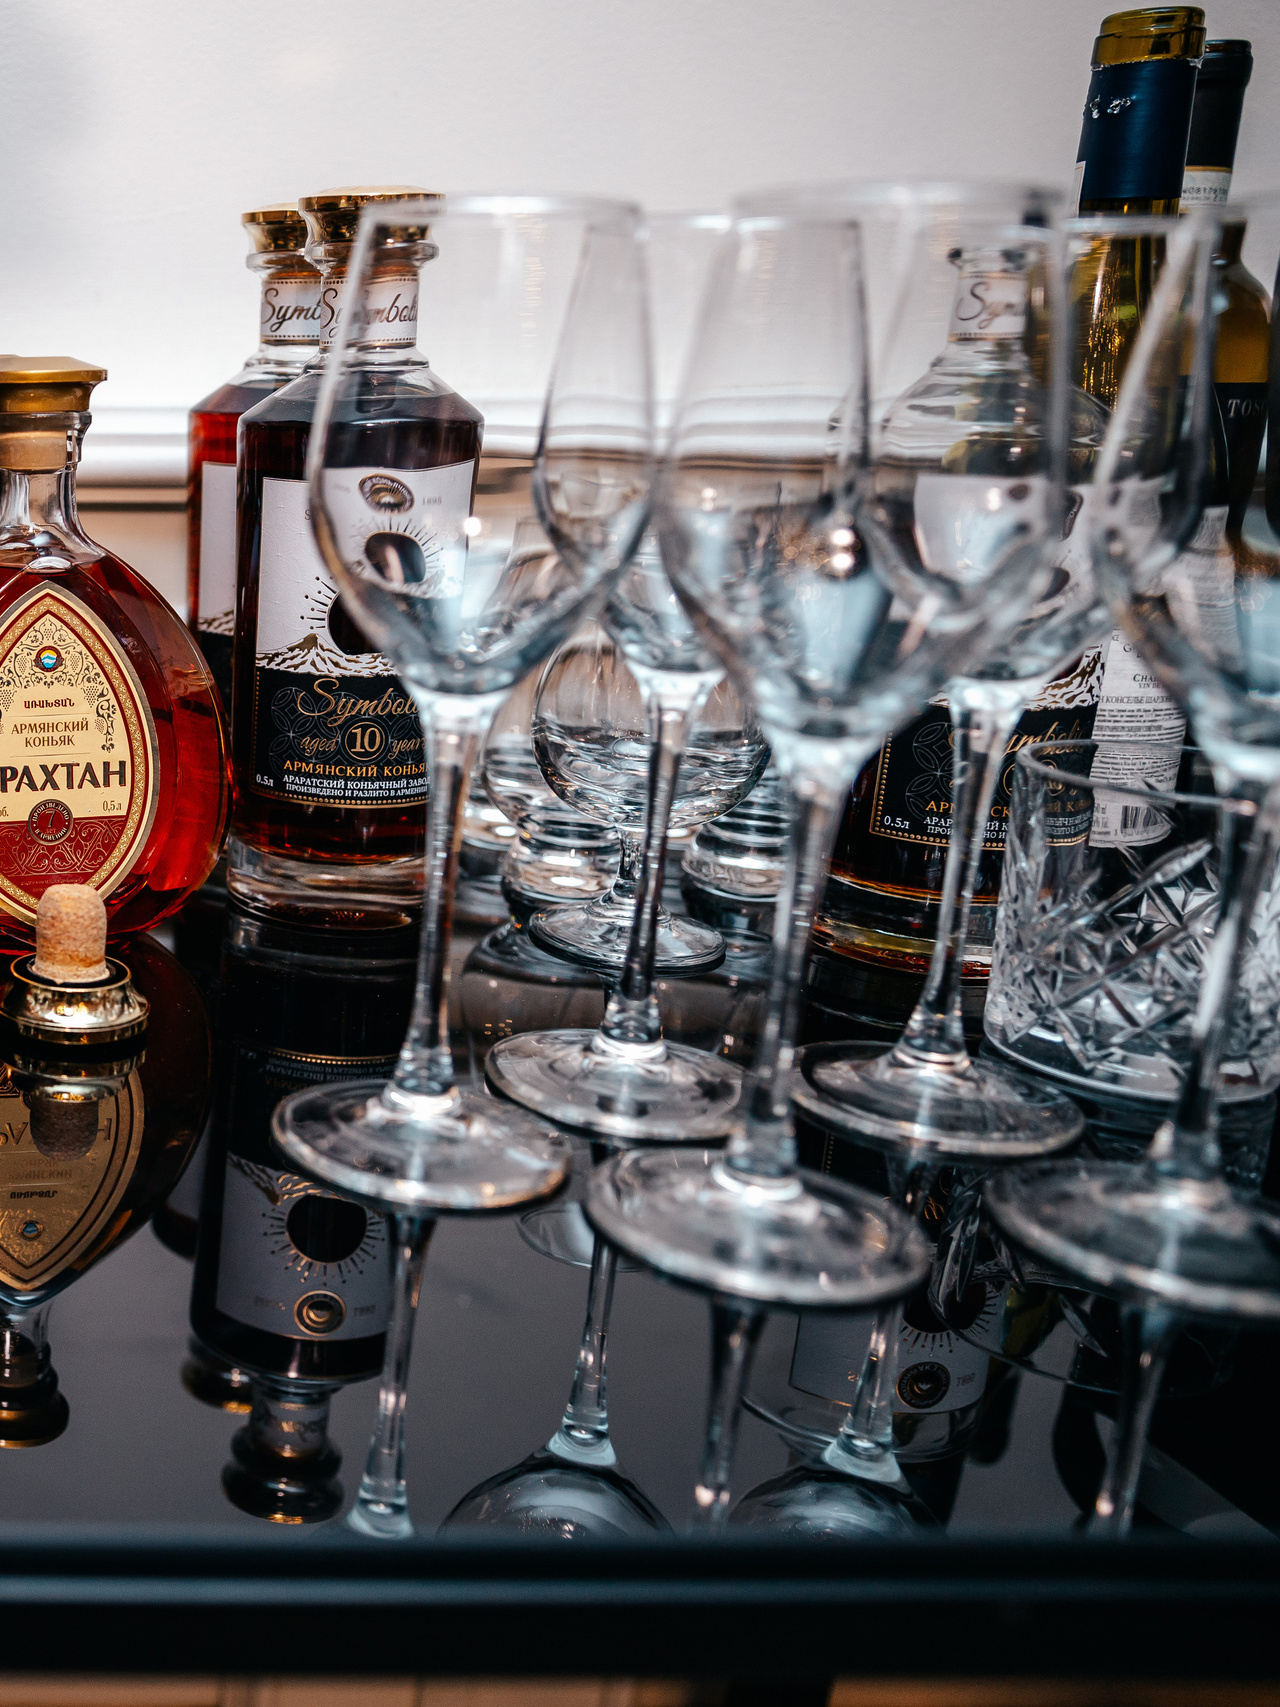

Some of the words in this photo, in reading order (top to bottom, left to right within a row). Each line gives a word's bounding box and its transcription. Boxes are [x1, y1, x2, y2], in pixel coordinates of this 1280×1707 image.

[11, 717, 89, 735] АРМЯНСКИЙ
[24, 735, 76, 748] КОНЬЯК
[300, 730, 340, 756] aged
[351, 727, 381, 752] 10
[283, 760, 377, 777] АРМЯНСКИЙ
[256, 773, 274, 787] 0.5л
[283, 774, 345, 789] АРАРАТСКИЙ
[347, 779, 407, 790] КОНЬЯЧНЫЙ
[285, 783, 344, 797] ПРОИЗВЕДЕНО
[345, 789, 353, 797] И
[353, 789, 389, 798] РАЗЛИТО
[390, 789, 396, 797] В
[45, 810, 57, 828] 7
[884, 815, 910, 830] 0.5л
